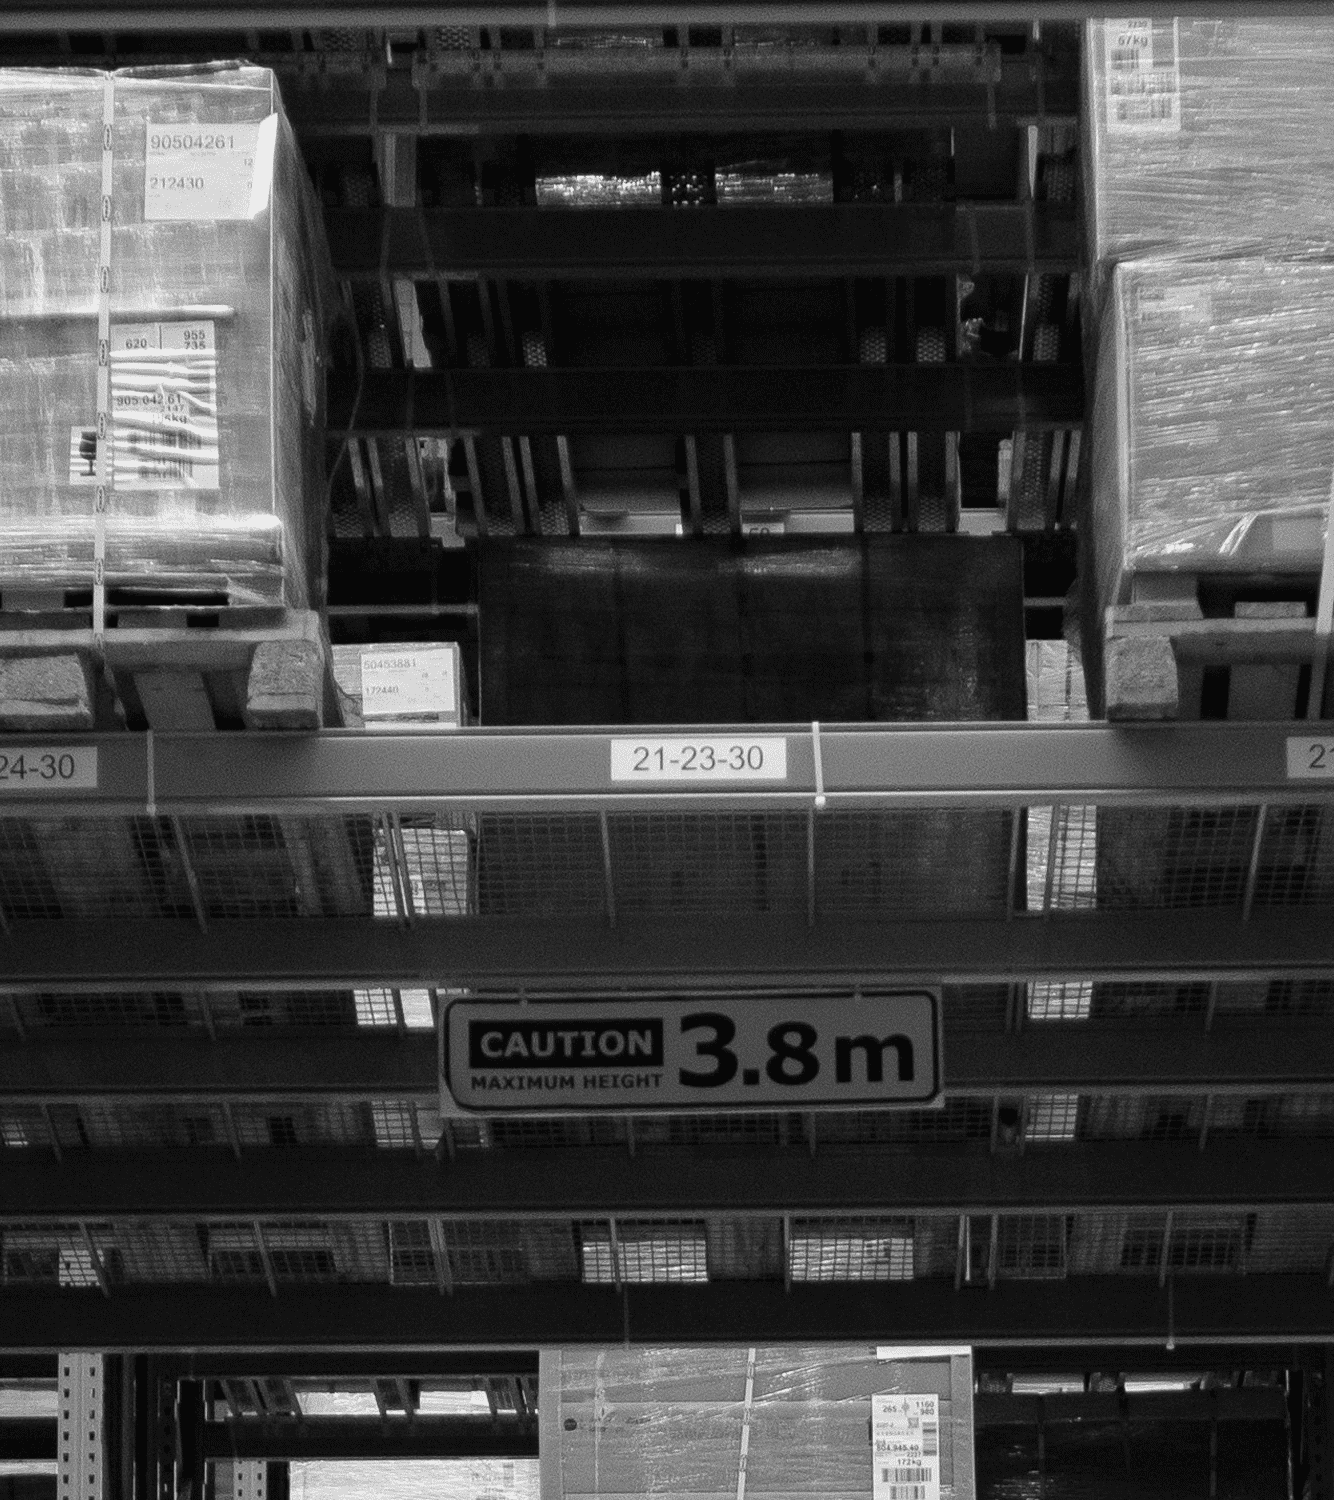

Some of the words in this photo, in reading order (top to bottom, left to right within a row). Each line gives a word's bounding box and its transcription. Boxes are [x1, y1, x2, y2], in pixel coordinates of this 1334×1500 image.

[151, 134, 234, 149] 90504261
[149, 177, 204, 190] 212430
[183, 329, 206, 341] 955
[125, 337, 148, 349] 620
[633, 745, 764, 771] 21-23-30
[480, 1028, 653, 1059] CAUTION
[470, 1075, 576, 1091] MAXIMUM
[583, 1073, 664, 1090] HEIGHT
